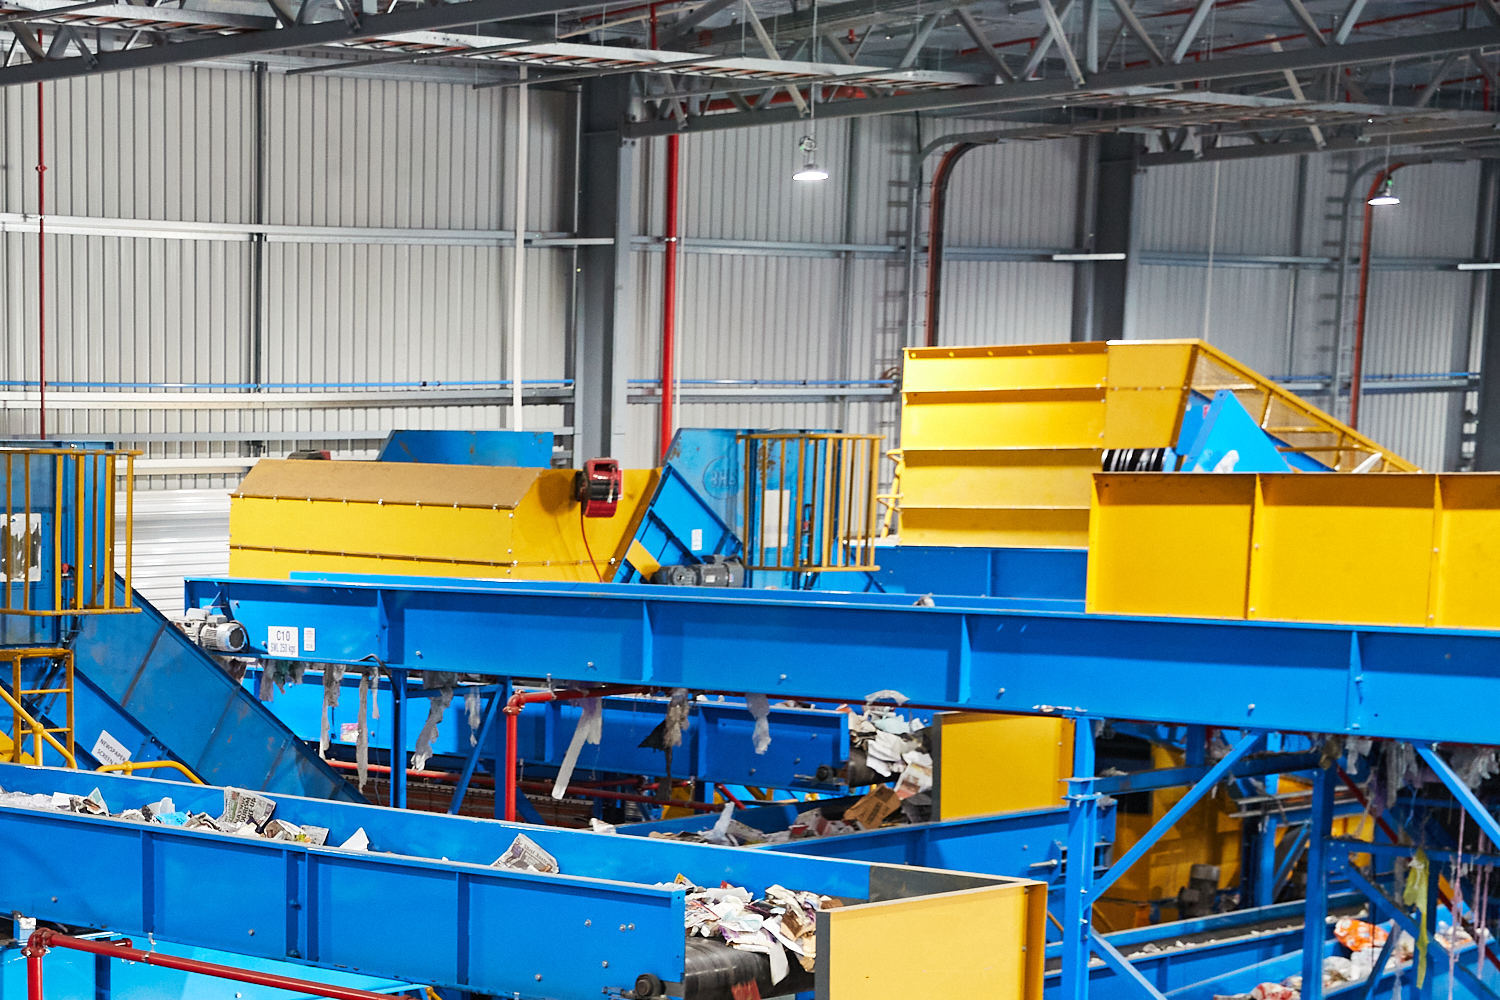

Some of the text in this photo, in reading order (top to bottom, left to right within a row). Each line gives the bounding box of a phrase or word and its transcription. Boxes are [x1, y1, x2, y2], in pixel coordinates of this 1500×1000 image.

[277, 630, 290, 641] C10
[97, 748, 113, 765] SCREEN
[100, 738, 126, 761] NEWSPAPER
